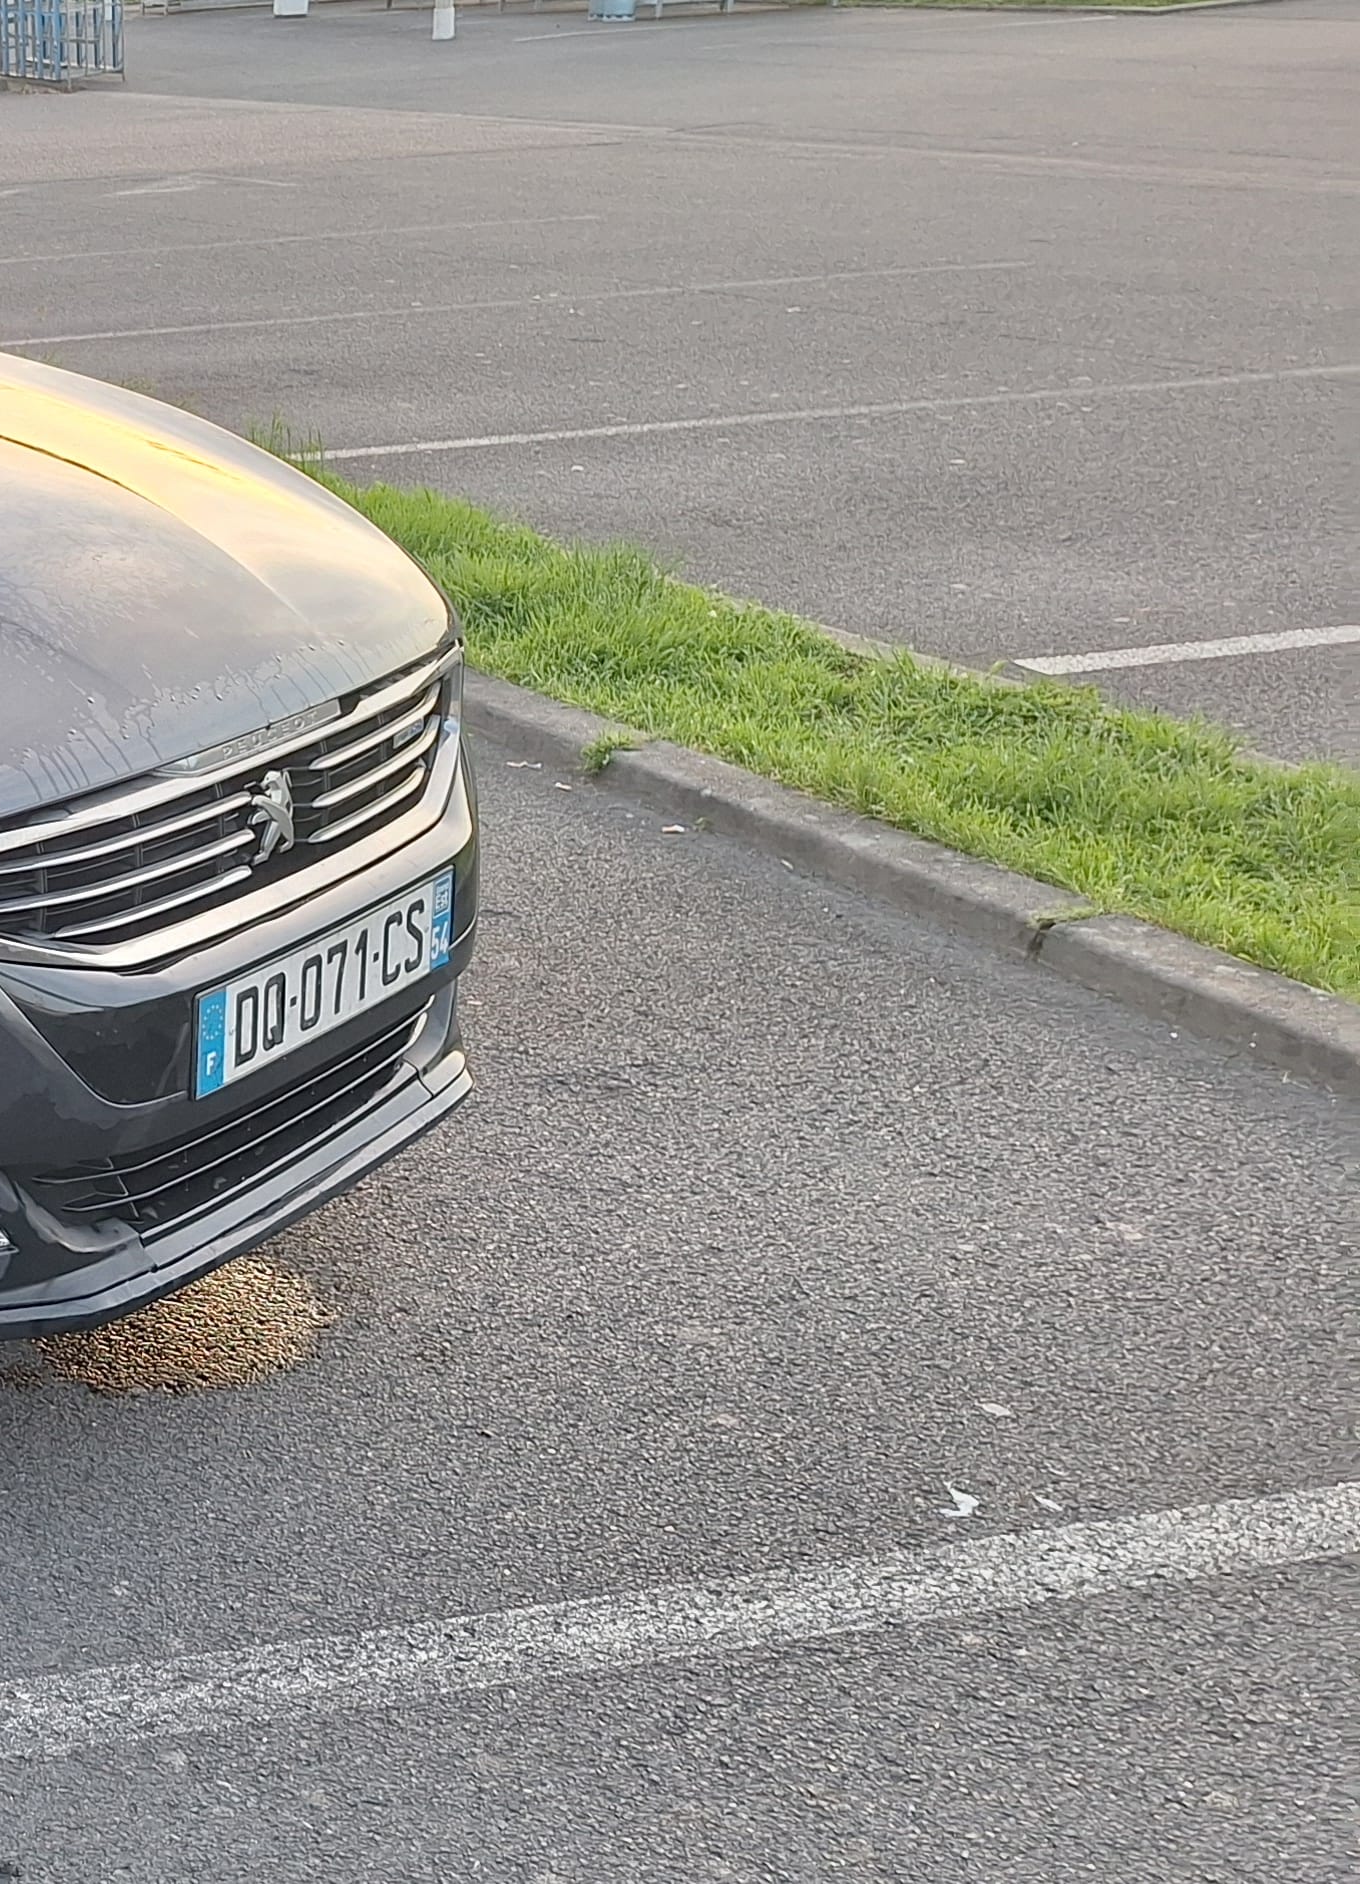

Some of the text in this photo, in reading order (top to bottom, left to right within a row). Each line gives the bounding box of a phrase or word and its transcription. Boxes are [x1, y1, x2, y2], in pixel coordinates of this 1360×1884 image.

[222, 711, 318, 759] PEUGEOT
[431, 921, 449, 960] 54
[234, 898, 424, 1068] DQ-071-CS
[205, 1051, 217, 1076] F
